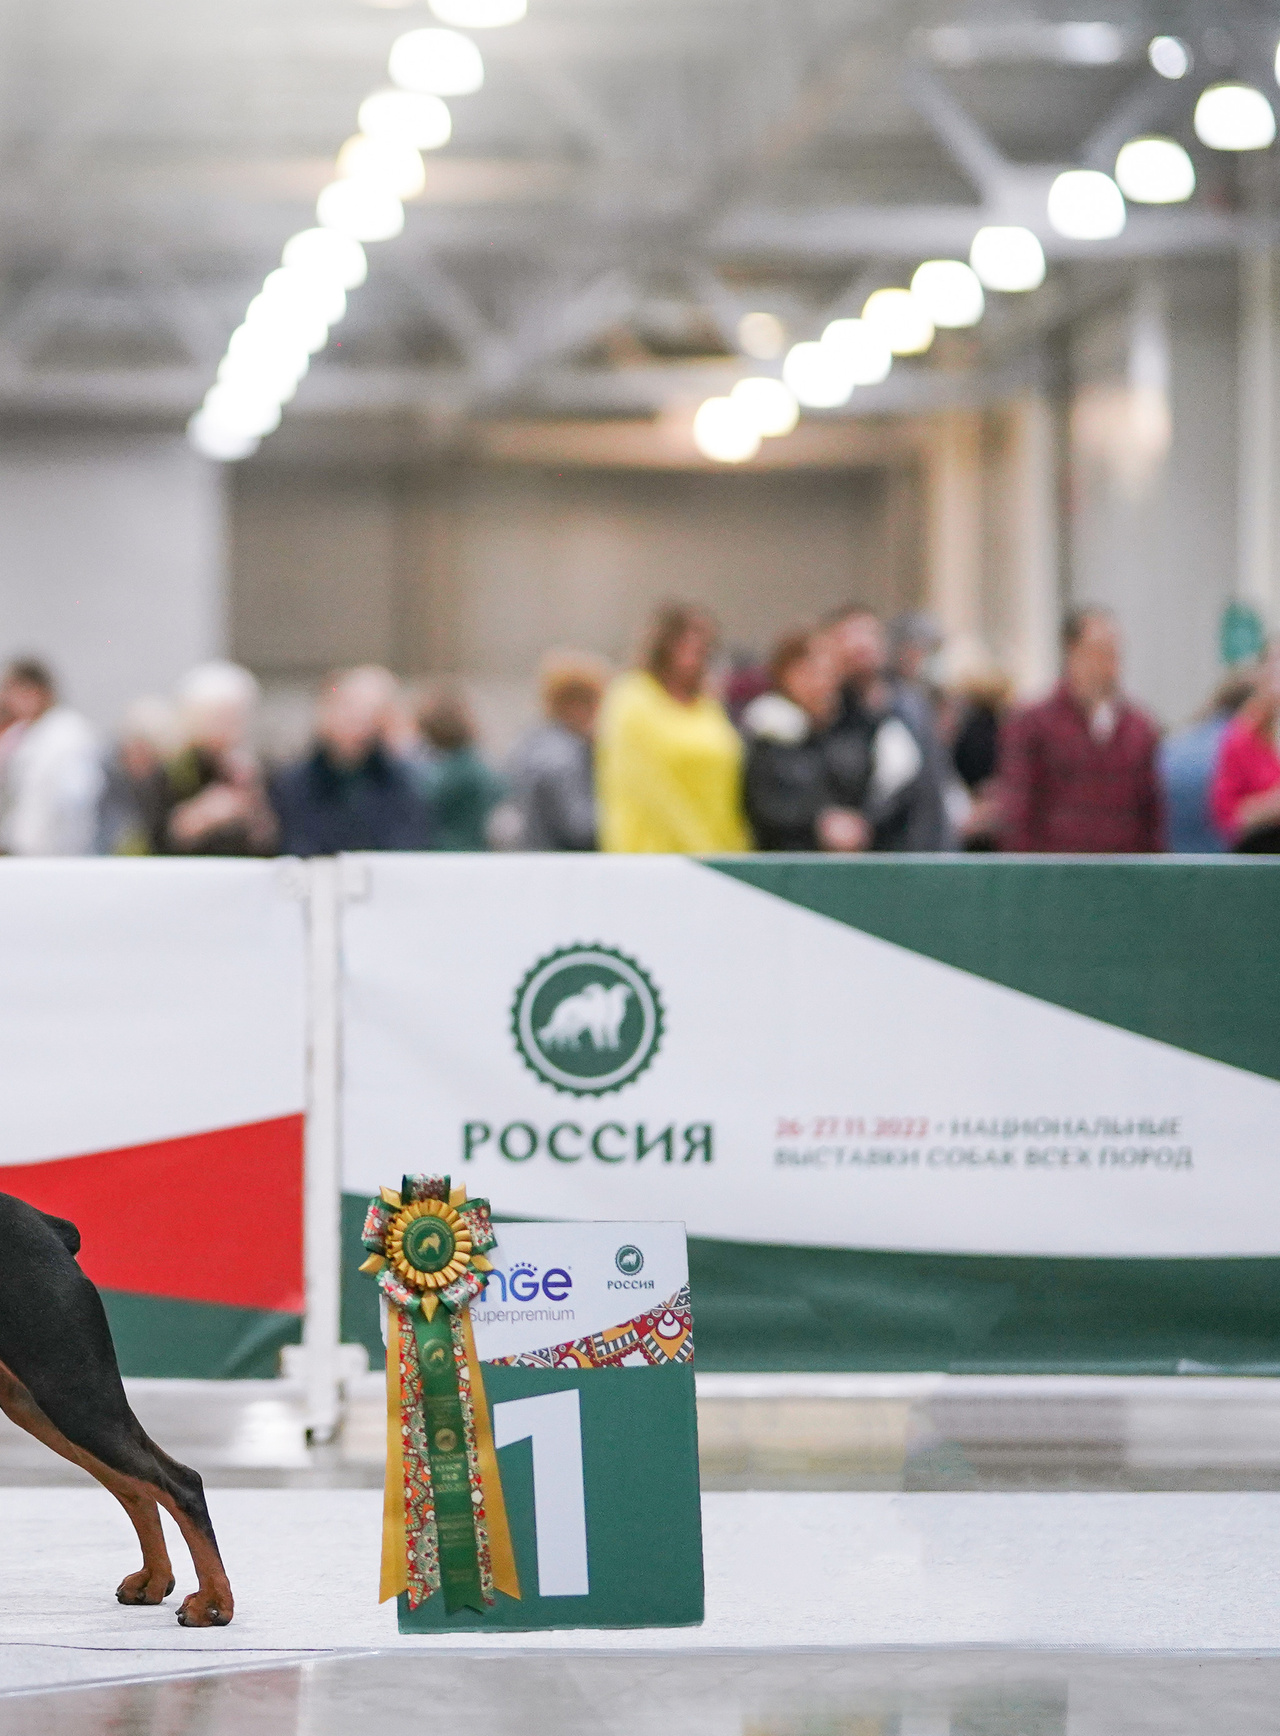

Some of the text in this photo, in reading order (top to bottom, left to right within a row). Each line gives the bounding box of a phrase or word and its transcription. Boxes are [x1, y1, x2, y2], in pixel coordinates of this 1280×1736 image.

[949, 1115, 1182, 1140] НАЦИОНАЛЬНЫЕ
[463, 1121, 714, 1164] РОССИЯ
[773, 1145, 1195, 1169] ВЫСТАВКИ СОБАК ВСЕХ ПОРОД
[607, 1279, 655, 1290] РОССИЯ
[469, 1307, 576, 1324] Superpremium
[493, 1388, 589, 1597] 1
